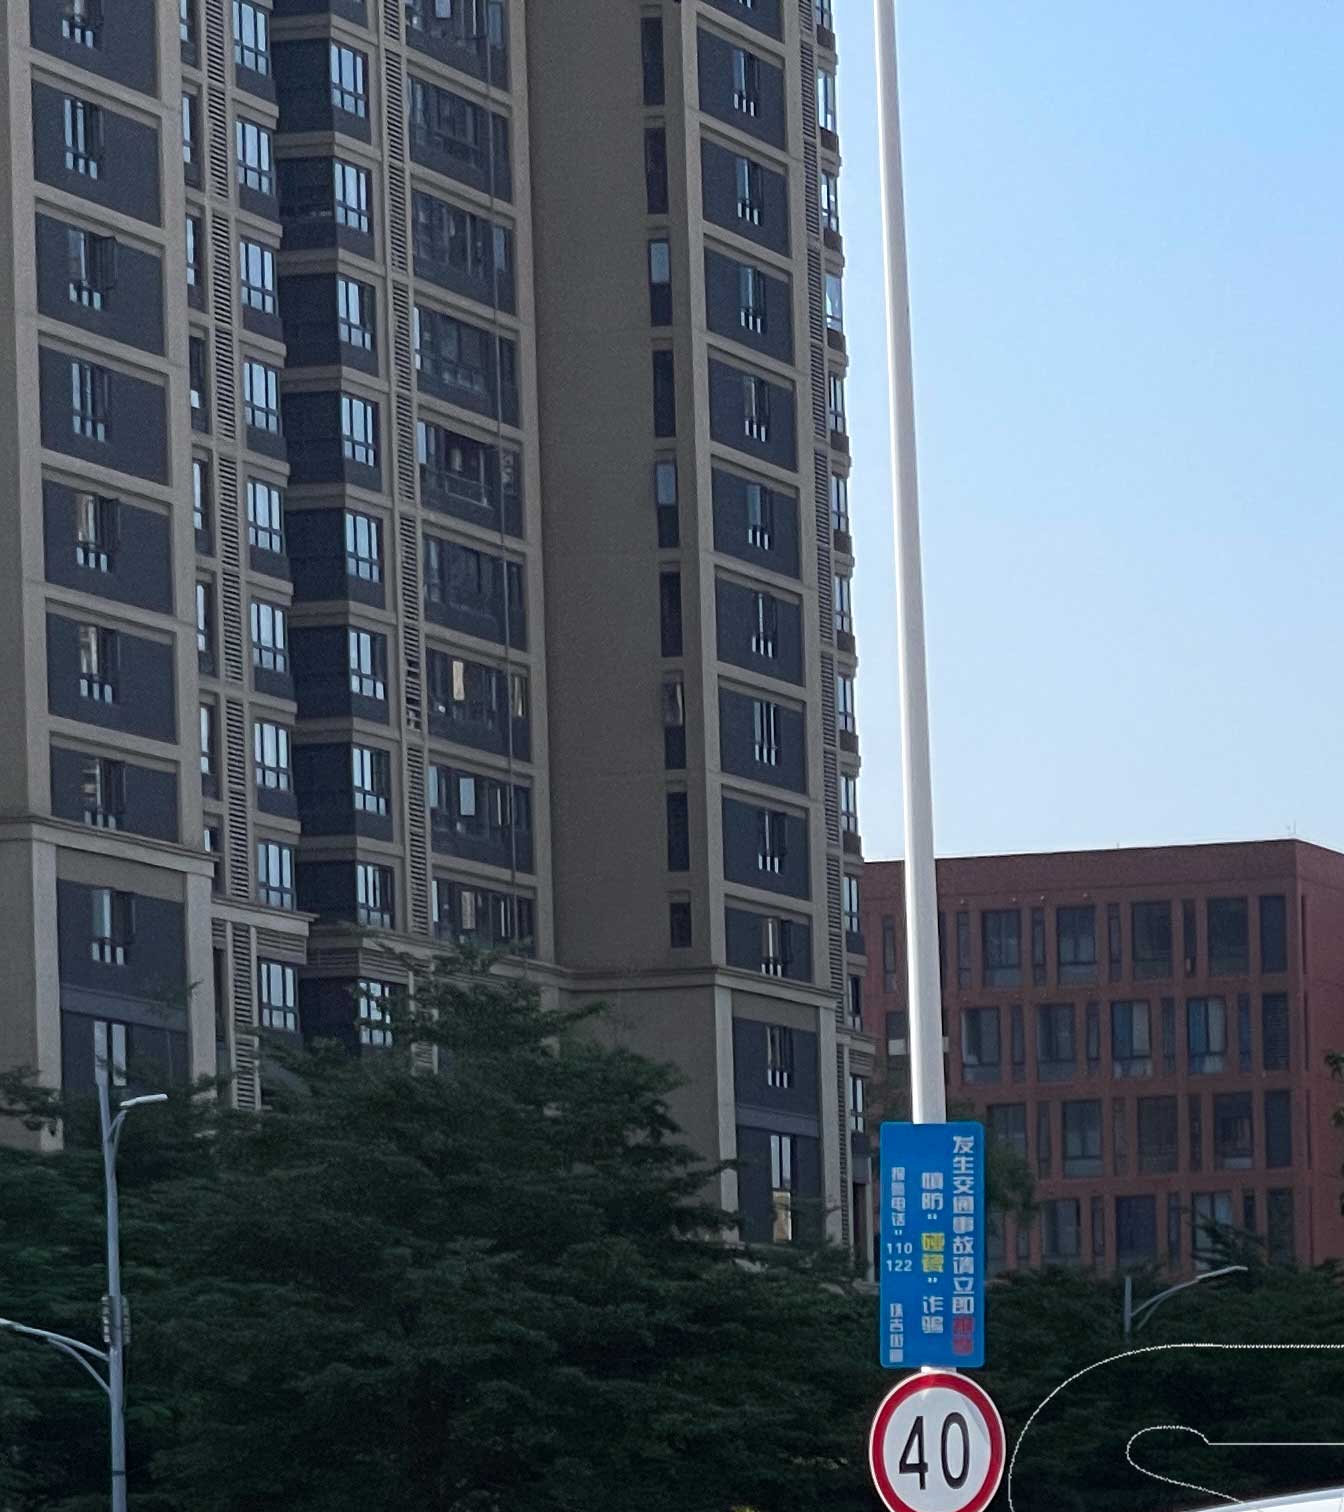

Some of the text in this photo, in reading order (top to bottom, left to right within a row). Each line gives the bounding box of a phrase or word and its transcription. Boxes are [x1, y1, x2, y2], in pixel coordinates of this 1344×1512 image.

[886, 1242, 913, 1255] 110
[886, 1259, 913, 1272] 122
[899, 1411, 970, 1490] 40
